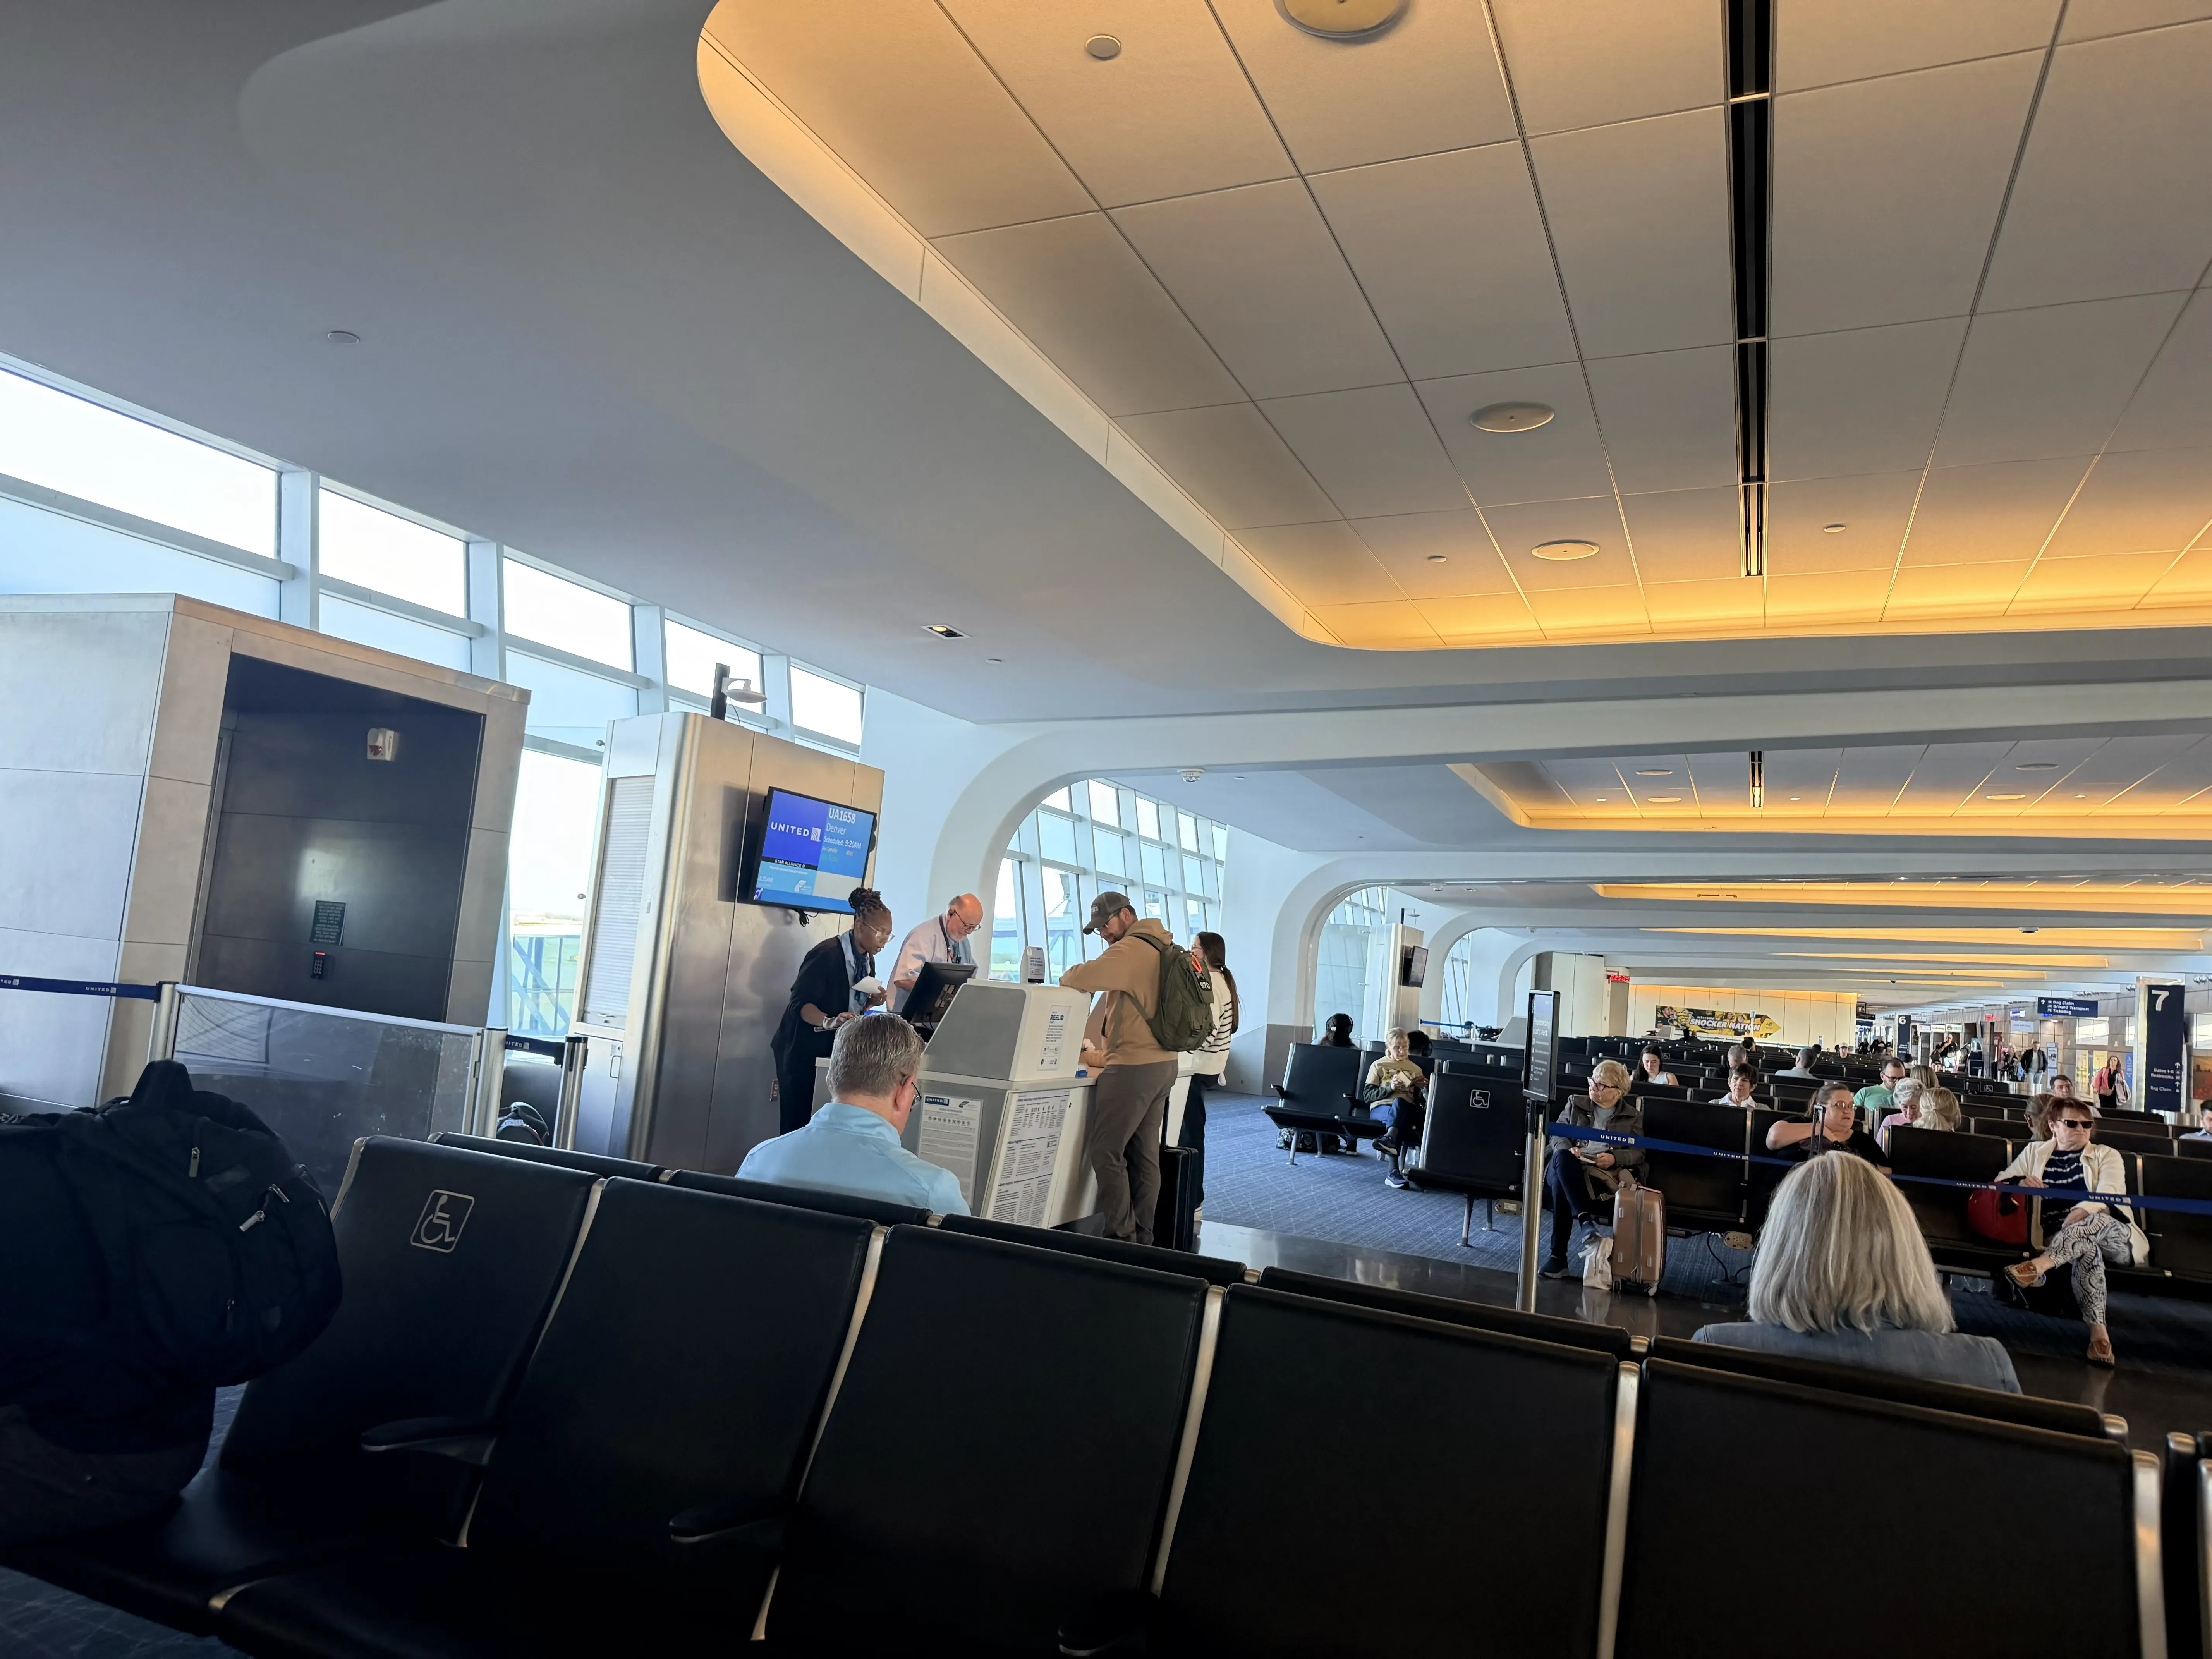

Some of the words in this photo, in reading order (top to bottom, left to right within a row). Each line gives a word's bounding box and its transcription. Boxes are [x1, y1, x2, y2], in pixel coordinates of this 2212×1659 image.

[829, 807, 856, 824] UA1658
[771, 821, 809, 836] UNITED
[826, 823, 846, 835] Denver
[845, 840, 861, 849] 9:20AM
[2152, 989, 2169, 1012] 7
[1690, 1018, 1727, 1028] SHOCKER
[1899, 1016, 1906, 1025] 6
